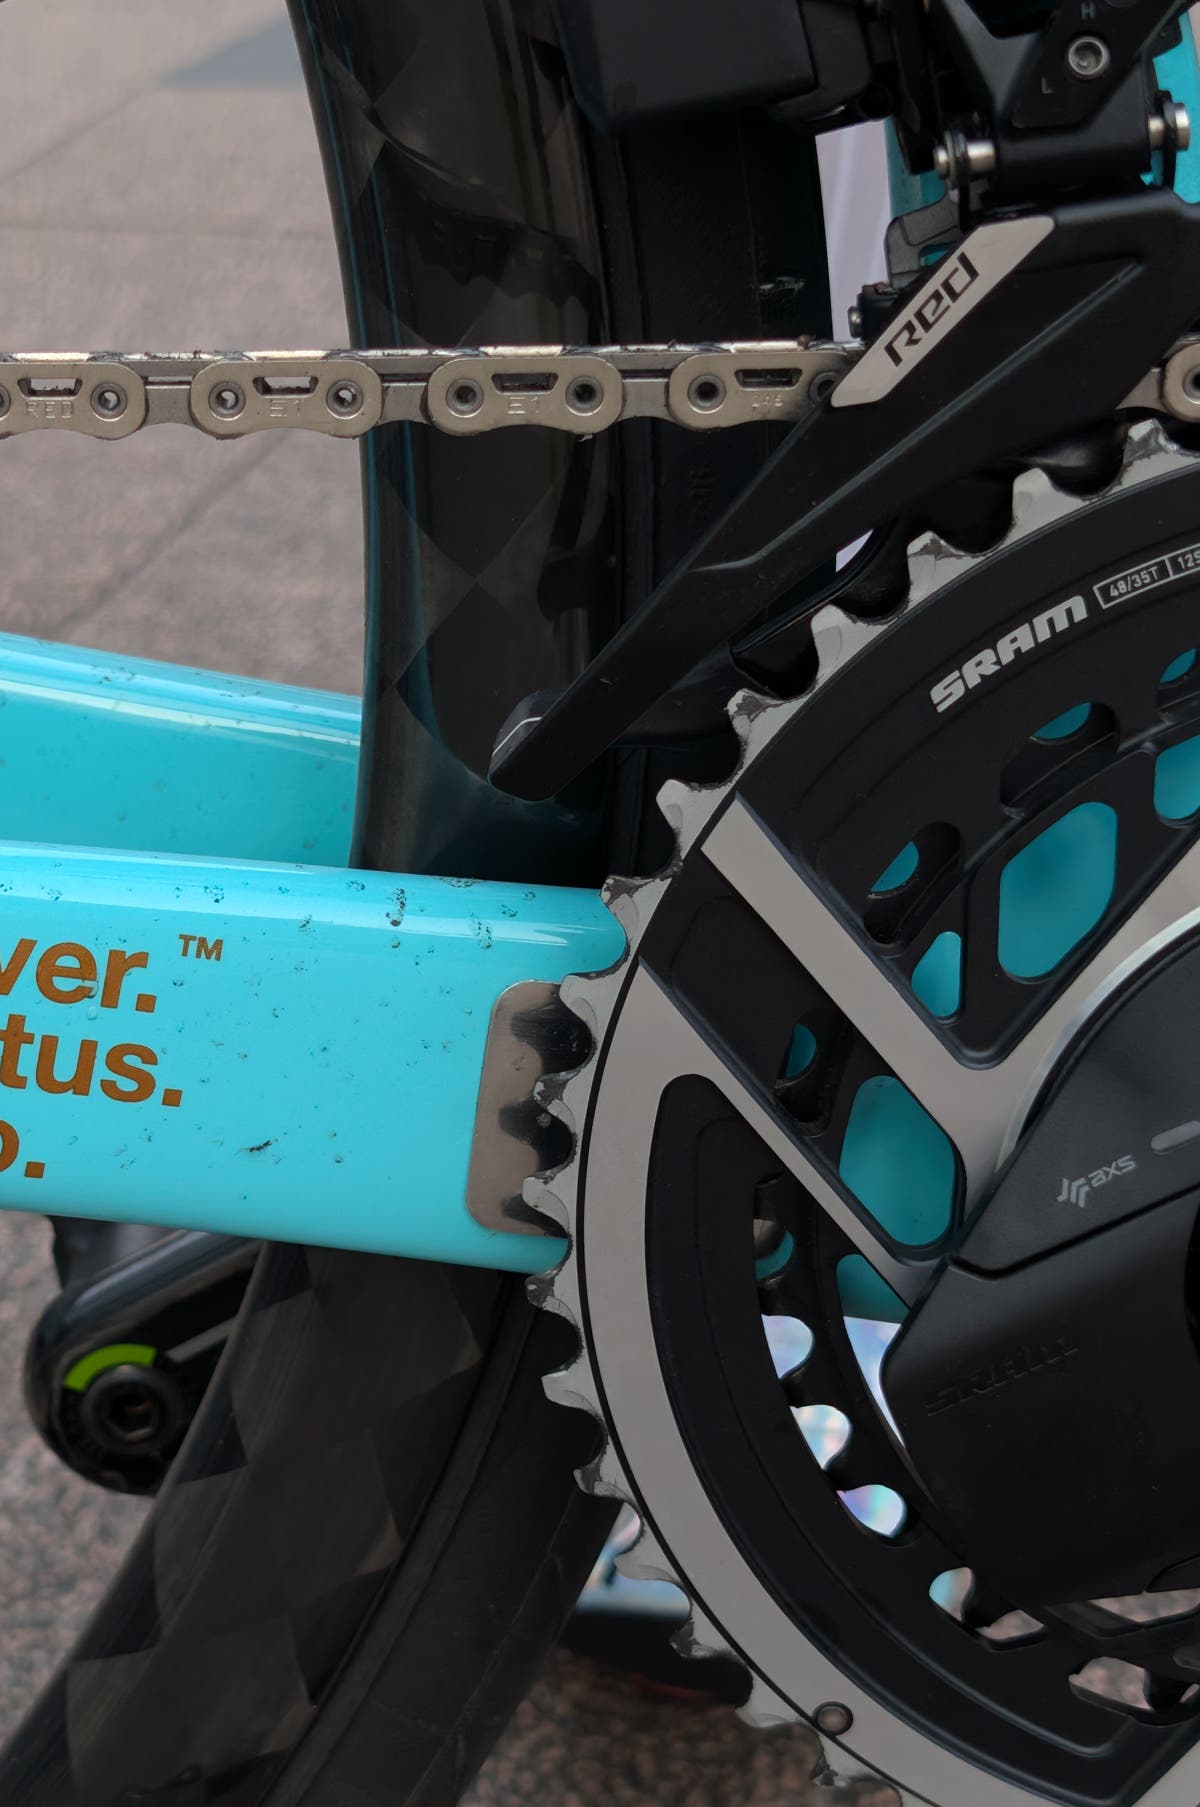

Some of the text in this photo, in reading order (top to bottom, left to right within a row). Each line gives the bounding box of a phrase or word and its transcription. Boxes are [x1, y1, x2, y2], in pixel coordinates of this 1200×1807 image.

[1080, 1, 1097, 20] H
[1040, 76, 1056, 94] L
[26, 401, 75, 418] RED
[1108, 566, 1160, 598] 48/35T
[929, 594, 1089, 713] SRAM
